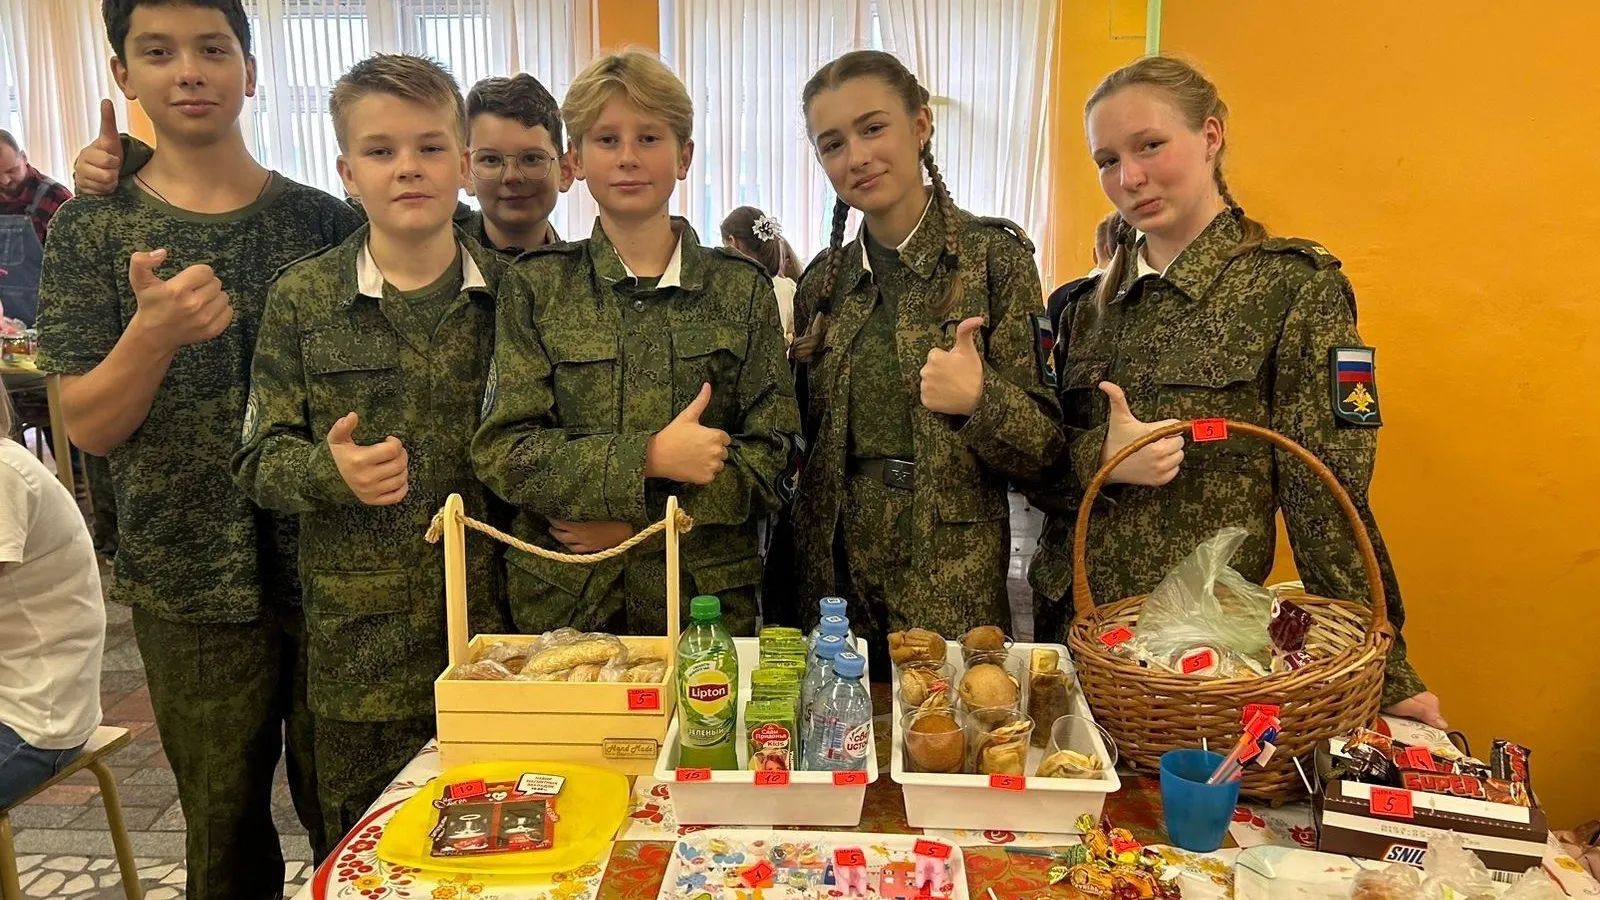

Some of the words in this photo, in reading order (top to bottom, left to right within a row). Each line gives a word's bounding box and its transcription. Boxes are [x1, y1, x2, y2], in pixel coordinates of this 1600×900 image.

[691, 687, 726, 699] Lipton
[636, 693, 653, 705] 5
[606, 744, 630, 753] Hand
[685, 771, 702, 780] 15
[764, 774, 781, 782] 10
[844, 774, 856, 783] 5
[1404, 773, 1485, 798] SUPER
[1383, 796, 1397, 812] 5
[850, 853, 861, 864] 5
